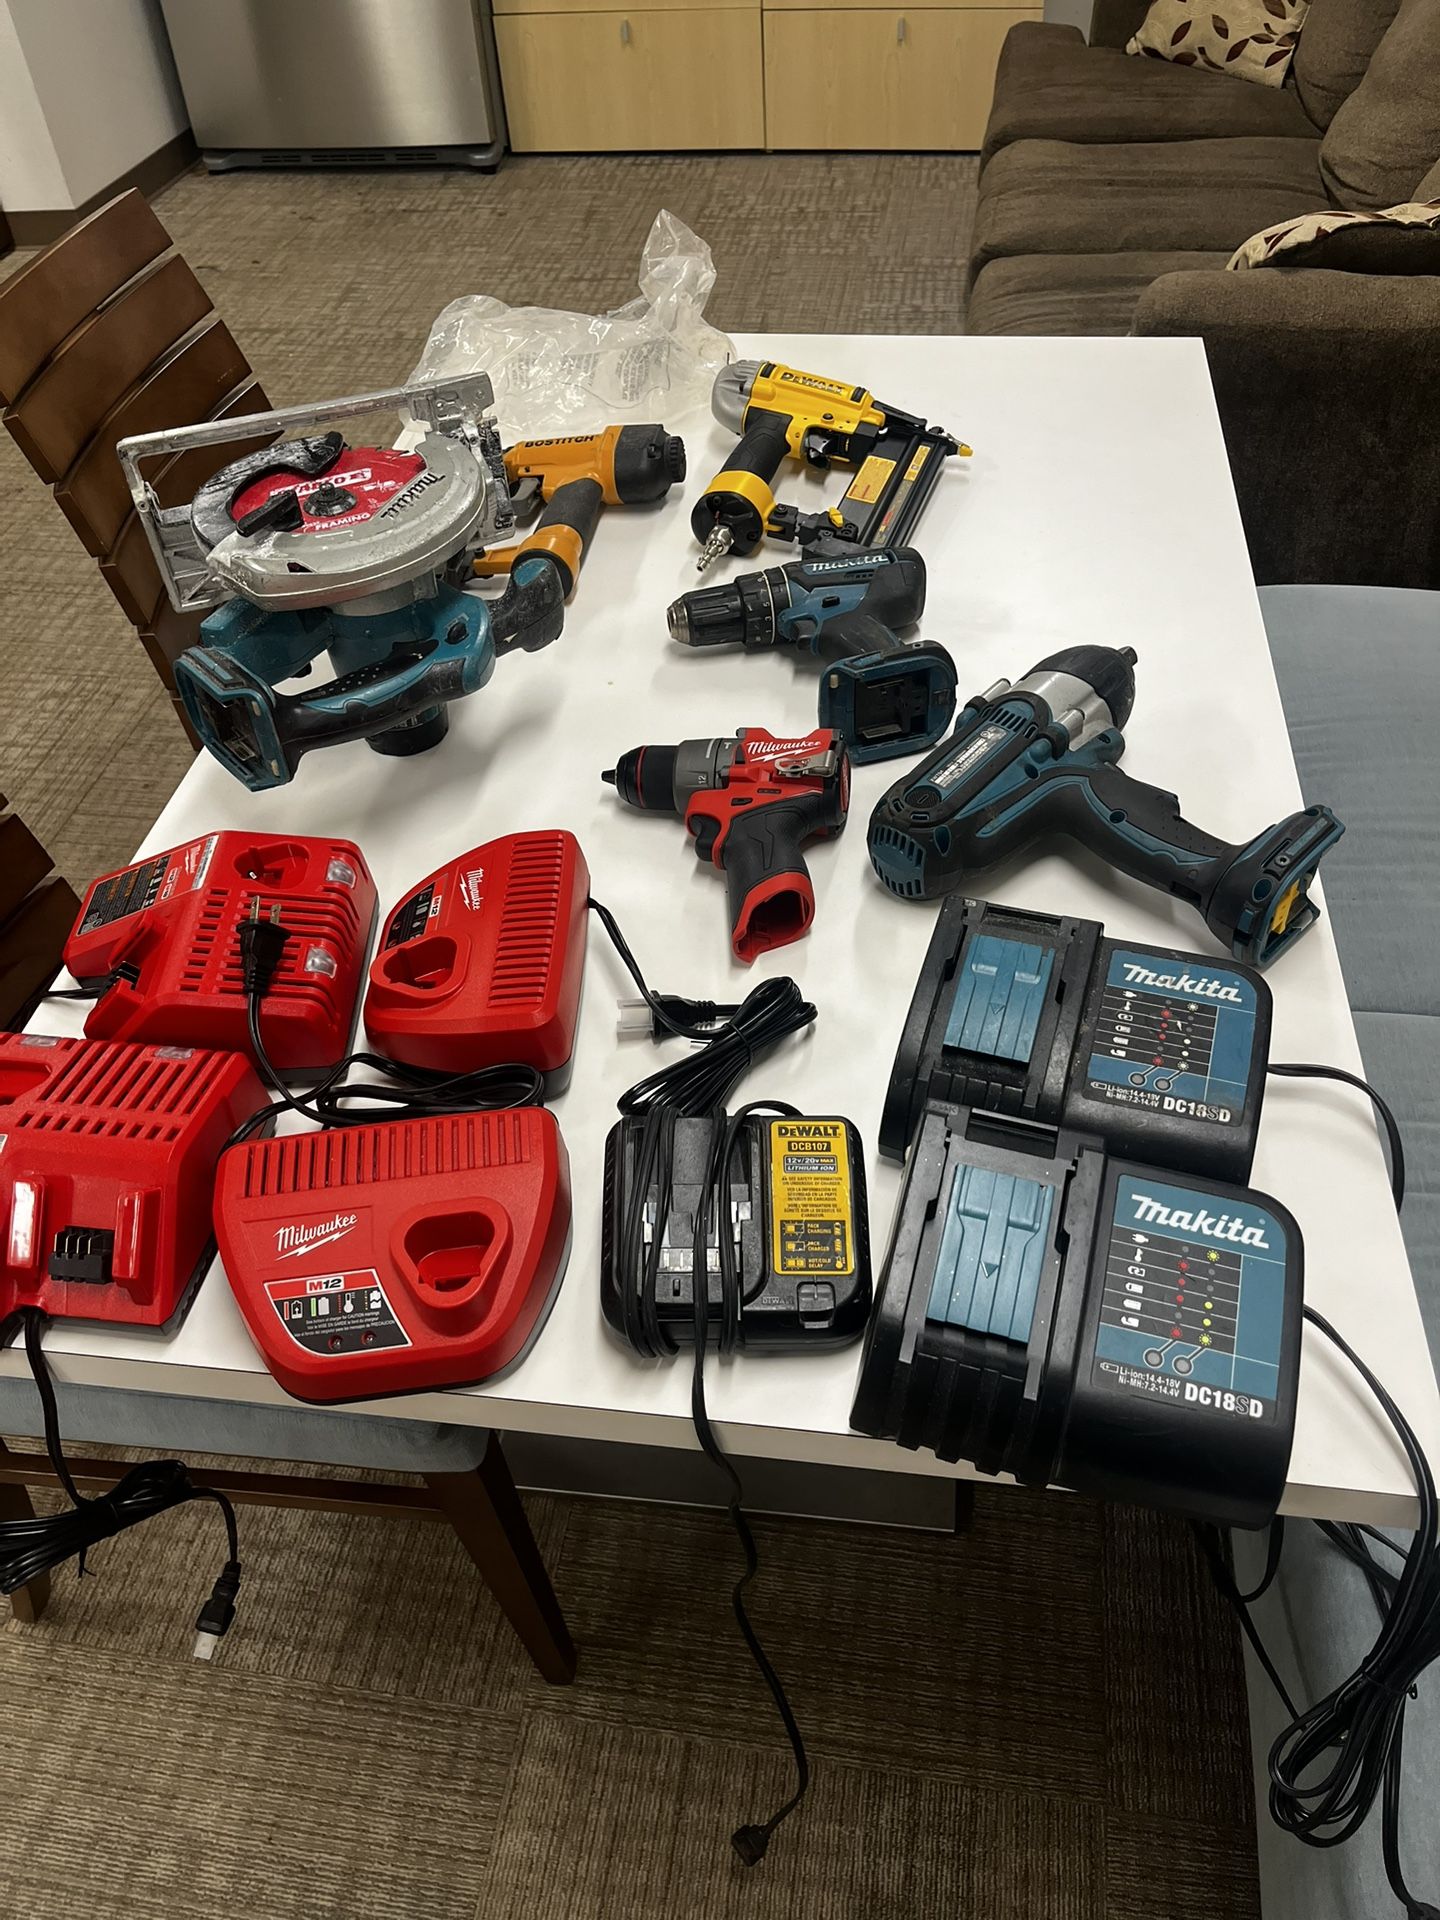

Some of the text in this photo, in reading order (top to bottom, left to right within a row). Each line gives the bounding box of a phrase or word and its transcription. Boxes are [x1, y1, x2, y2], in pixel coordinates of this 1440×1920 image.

[525, 435, 594, 448] BOSTITCH
[746, 740, 821, 754] Milwaukee
[466, 866, 485, 911] Milwaukee
[430, 897, 440, 915] M12
[1162, 1096, 1231, 1123] DC18SD
[791, 1142, 828, 1151] DCB107
[273, 1214, 358, 1252] Milwaukee
[308, 1278, 342, 1292] M12
[1119, 1375, 1180, 1397] Ni-MH:7.2-14.4V
[1120, 1366, 1180, 1388] Li-ion:14.4-18V
[1184, 1382, 1263, 1418] DC18SD
